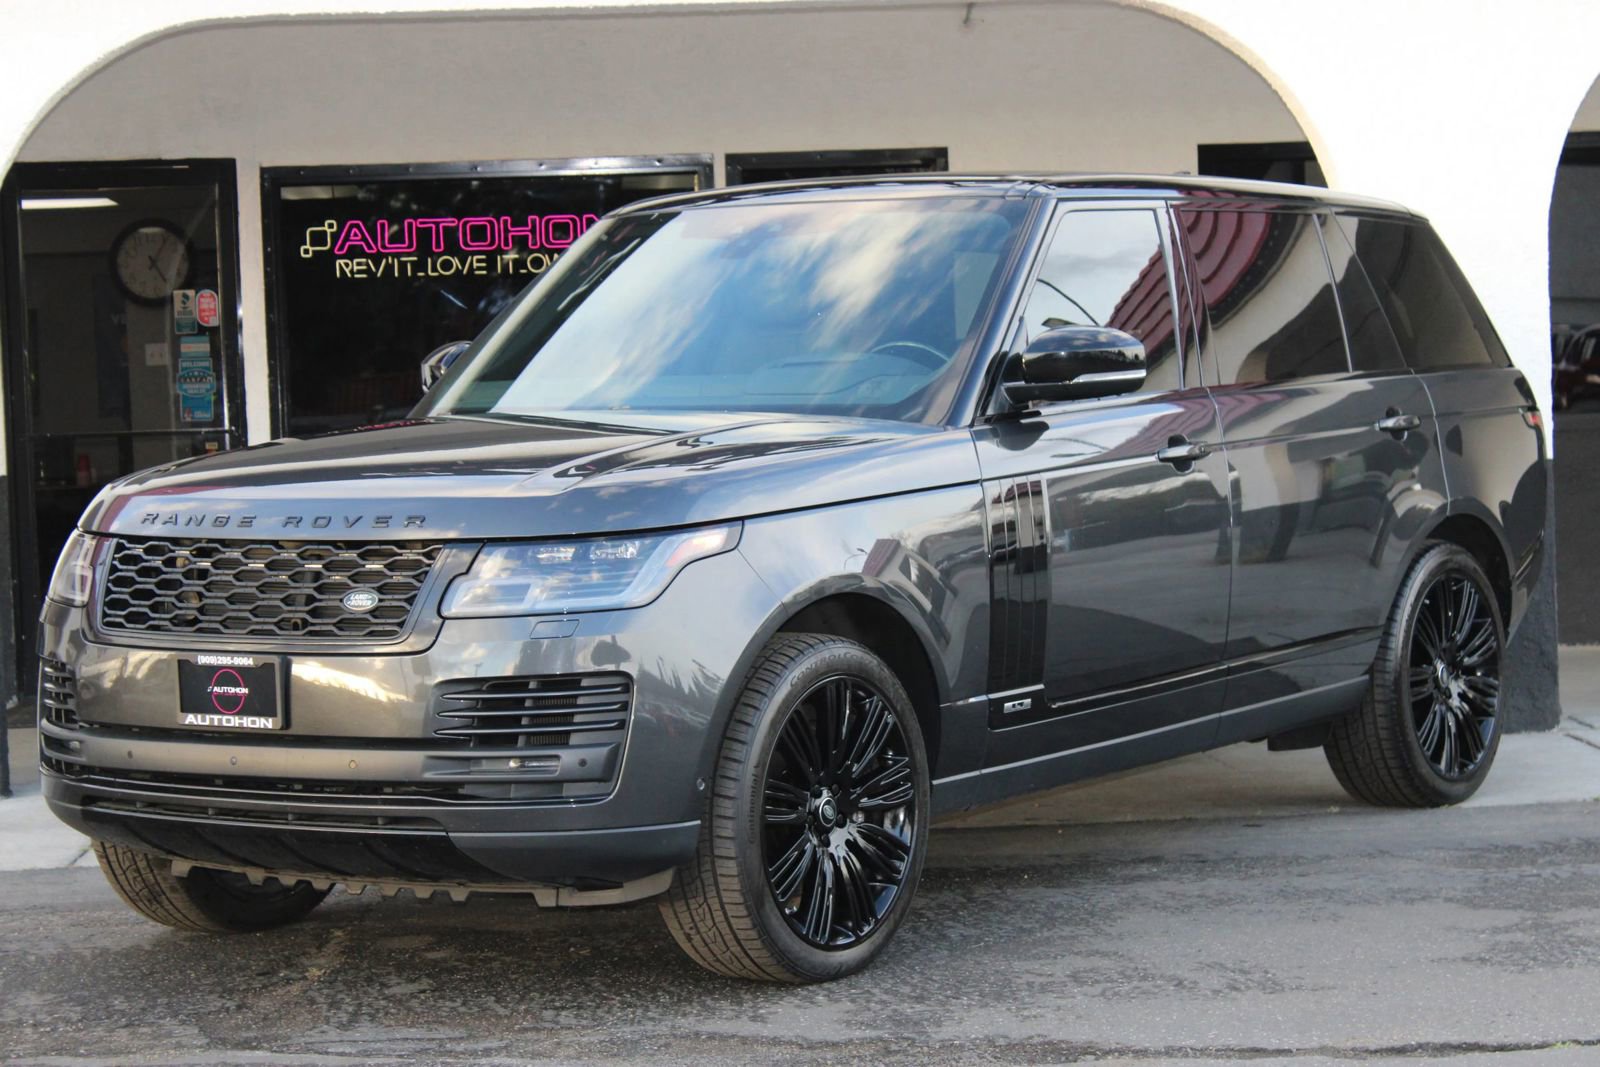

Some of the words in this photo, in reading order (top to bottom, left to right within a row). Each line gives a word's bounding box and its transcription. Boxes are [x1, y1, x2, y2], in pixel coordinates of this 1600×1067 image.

[140, 512, 257, 528] RANGE
[281, 514, 426, 529] ROVER
[213, 686, 249, 695] AUTOHON
[184, 714, 274, 729] AUTOHON
